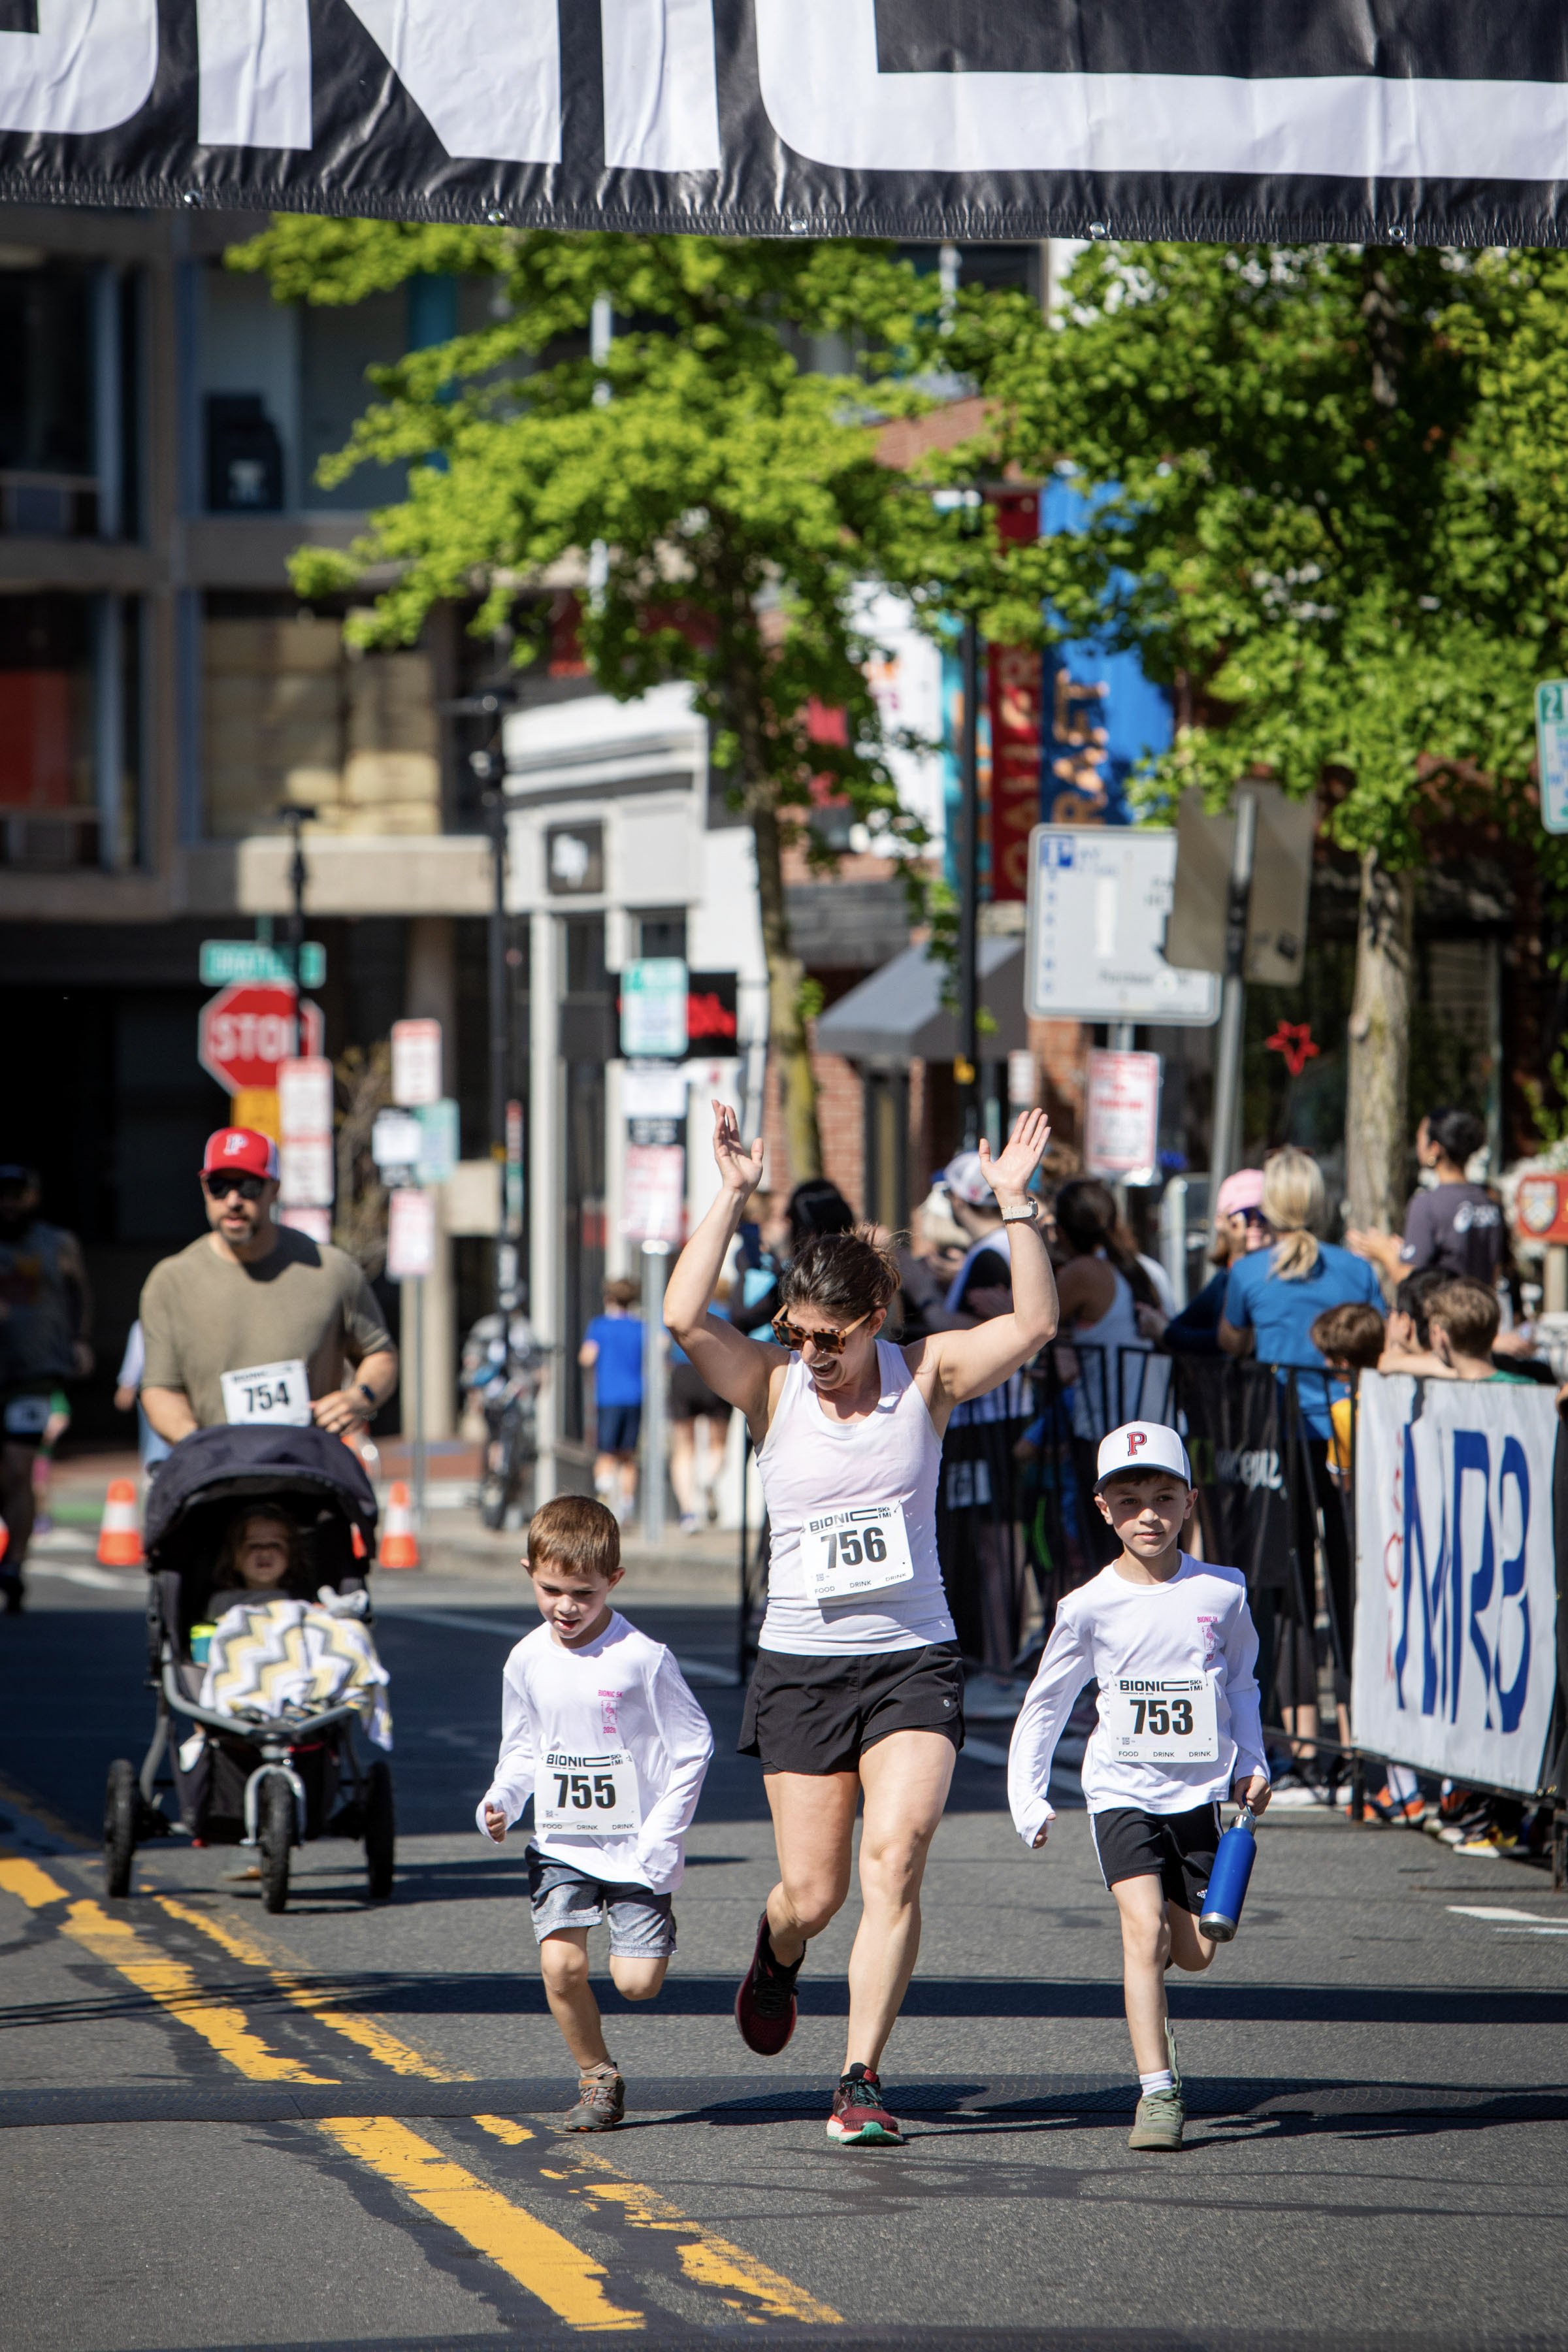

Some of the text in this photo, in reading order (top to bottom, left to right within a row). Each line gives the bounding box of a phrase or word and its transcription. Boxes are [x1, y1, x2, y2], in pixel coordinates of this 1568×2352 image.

[242, 1380, 289, 1413] 754
[1127, 1431, 1147, 1456] P
[809, 1509, 878, 1532] BIONIC
[821, 1527, 887, 1569] 756
[815, 1586, 836, 1594] FOOD
[885, 1573, 907, 1582] DRINK
[1119, 1680, 1189, 1692] BIONIC
[1130, 1699, 1193, 1735] 753
[546, 1754, 611, 1767] BIONIC
[553, 1773, 616, 1809] 755
